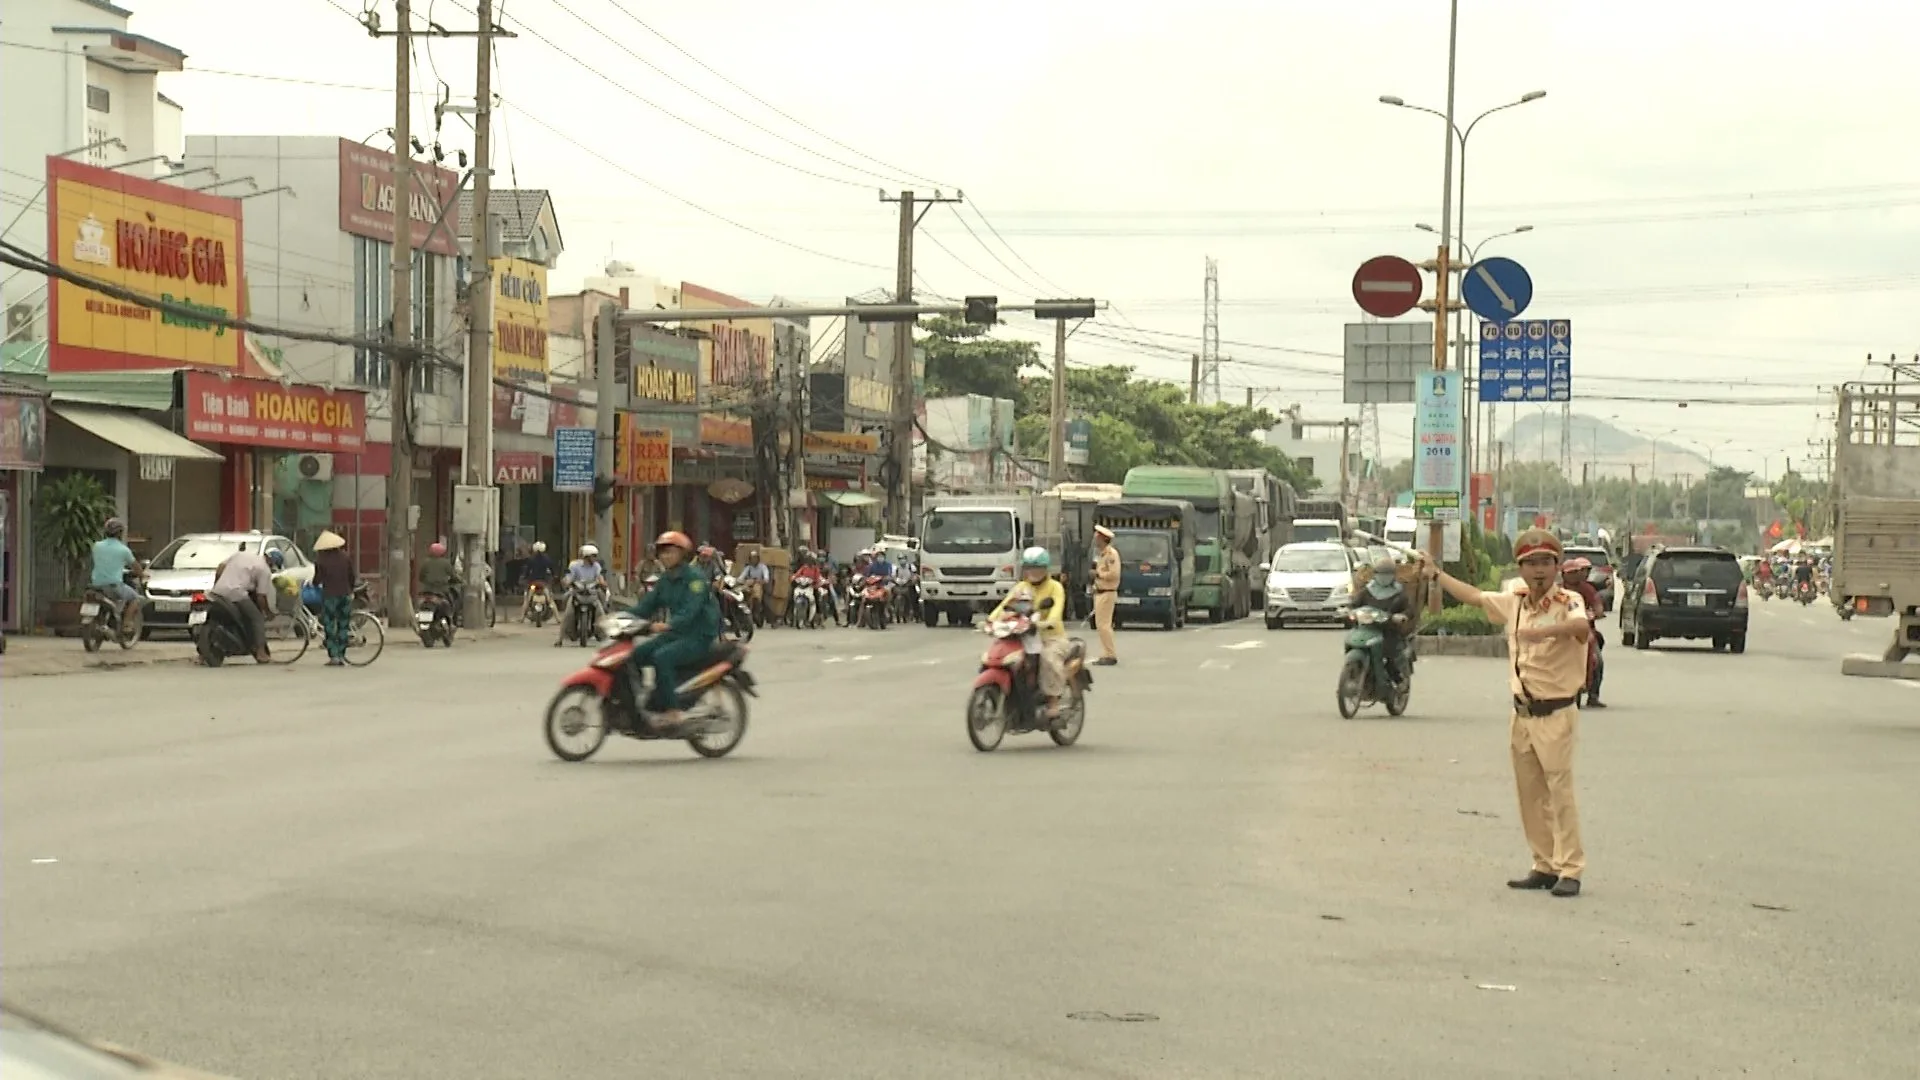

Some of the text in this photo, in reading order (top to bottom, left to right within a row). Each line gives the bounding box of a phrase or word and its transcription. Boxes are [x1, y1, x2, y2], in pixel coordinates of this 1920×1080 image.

[116, 212, 227, 288] HOÀNG GIA
[1485, 327, 1497, 336] 70
[323, 400, 353, 429] GIA
[1426, 447, 1451, 456] 2018
[497, 466, 537, 480] ATM
